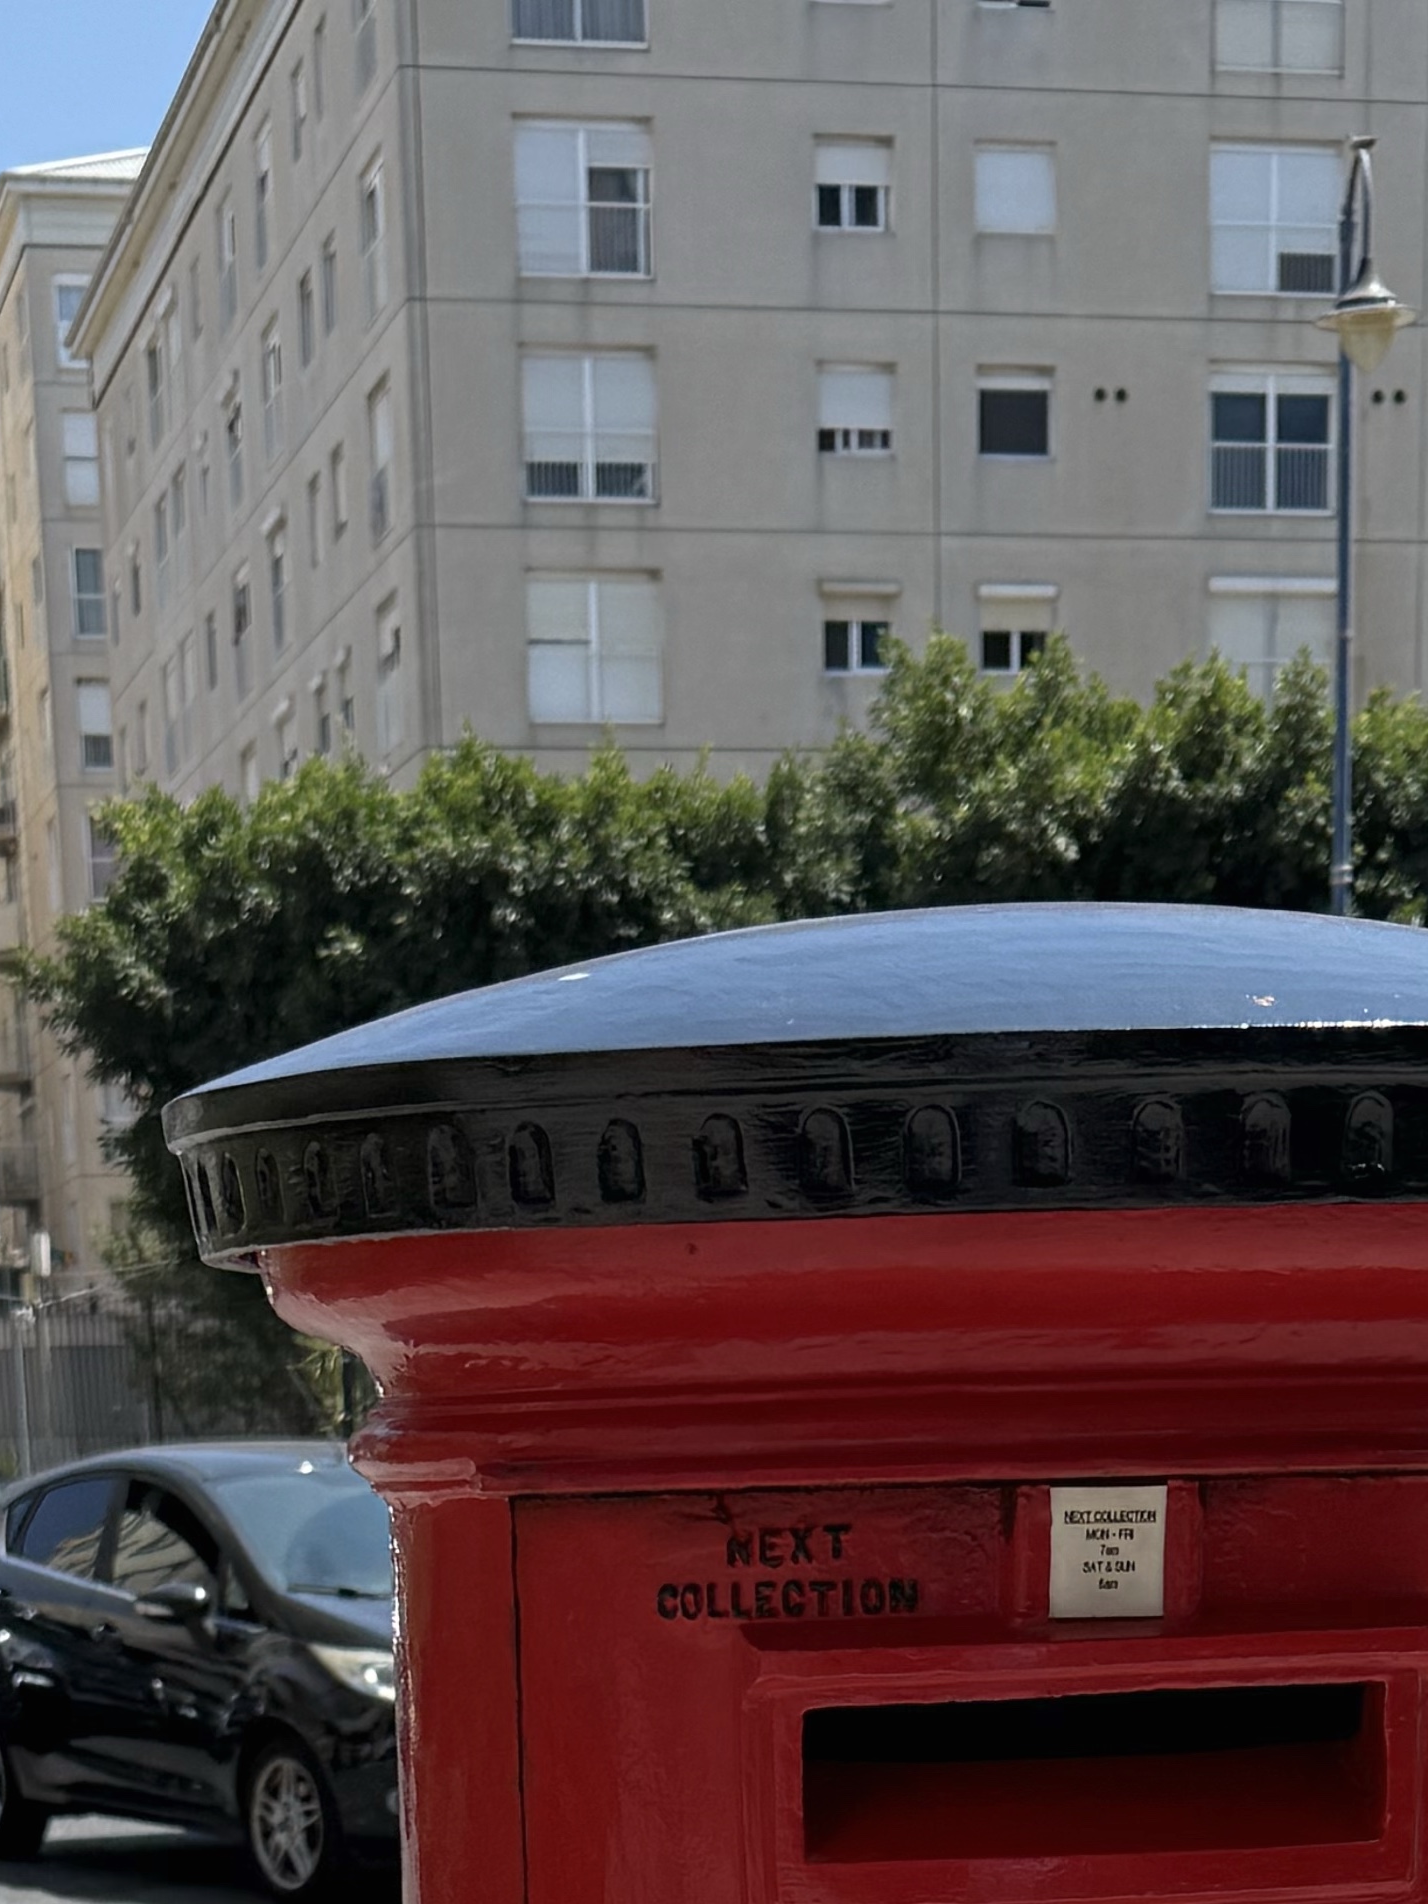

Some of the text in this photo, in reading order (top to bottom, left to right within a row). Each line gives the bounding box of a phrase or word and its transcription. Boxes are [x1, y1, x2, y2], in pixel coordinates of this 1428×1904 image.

[1064, 1509, 1156, 1523] NEXT COLLECTION
[1086, 1528, 1110, 1540] MON
[1118, 1528, 1134, 1540] FRI
[726, 1523, 853, 1568] NEXT
[1100, 1544, 1120, 1556] 7am
[1082, 1560, 1136, 1573] SAT & SUN
[656, 1576, 919, 1621] COLLECTION
